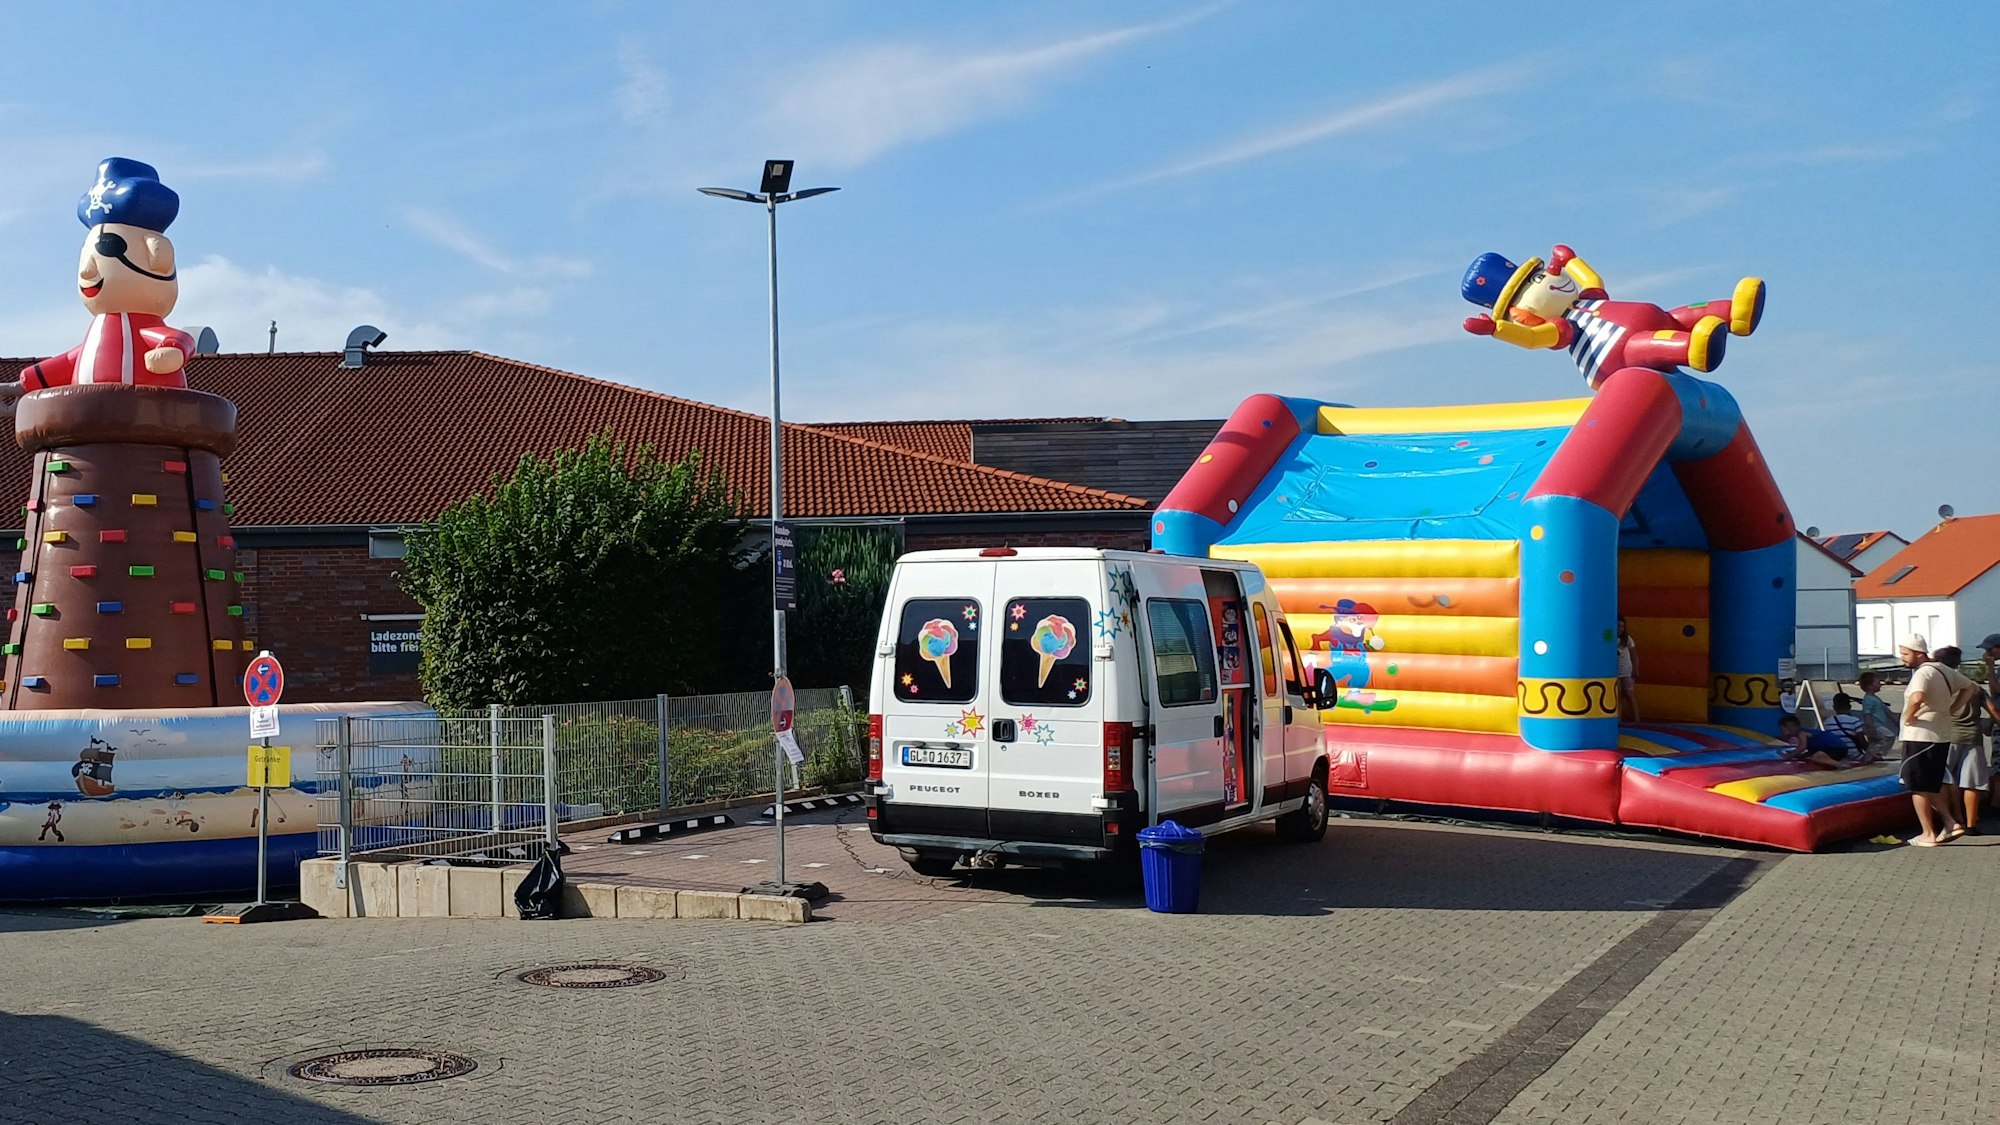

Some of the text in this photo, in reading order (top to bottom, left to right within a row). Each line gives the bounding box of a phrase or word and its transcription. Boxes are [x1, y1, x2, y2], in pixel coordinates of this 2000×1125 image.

[370, 630, 422, 642] Ladezone
[370, 642, 397, 653] bitte
[910, 750, 922, 762] GL
[937, 752, 962, 764] 1637
[909, 784, 961, 794] PEUGEOT
[1018, 790, 1060, 799] BOXER
